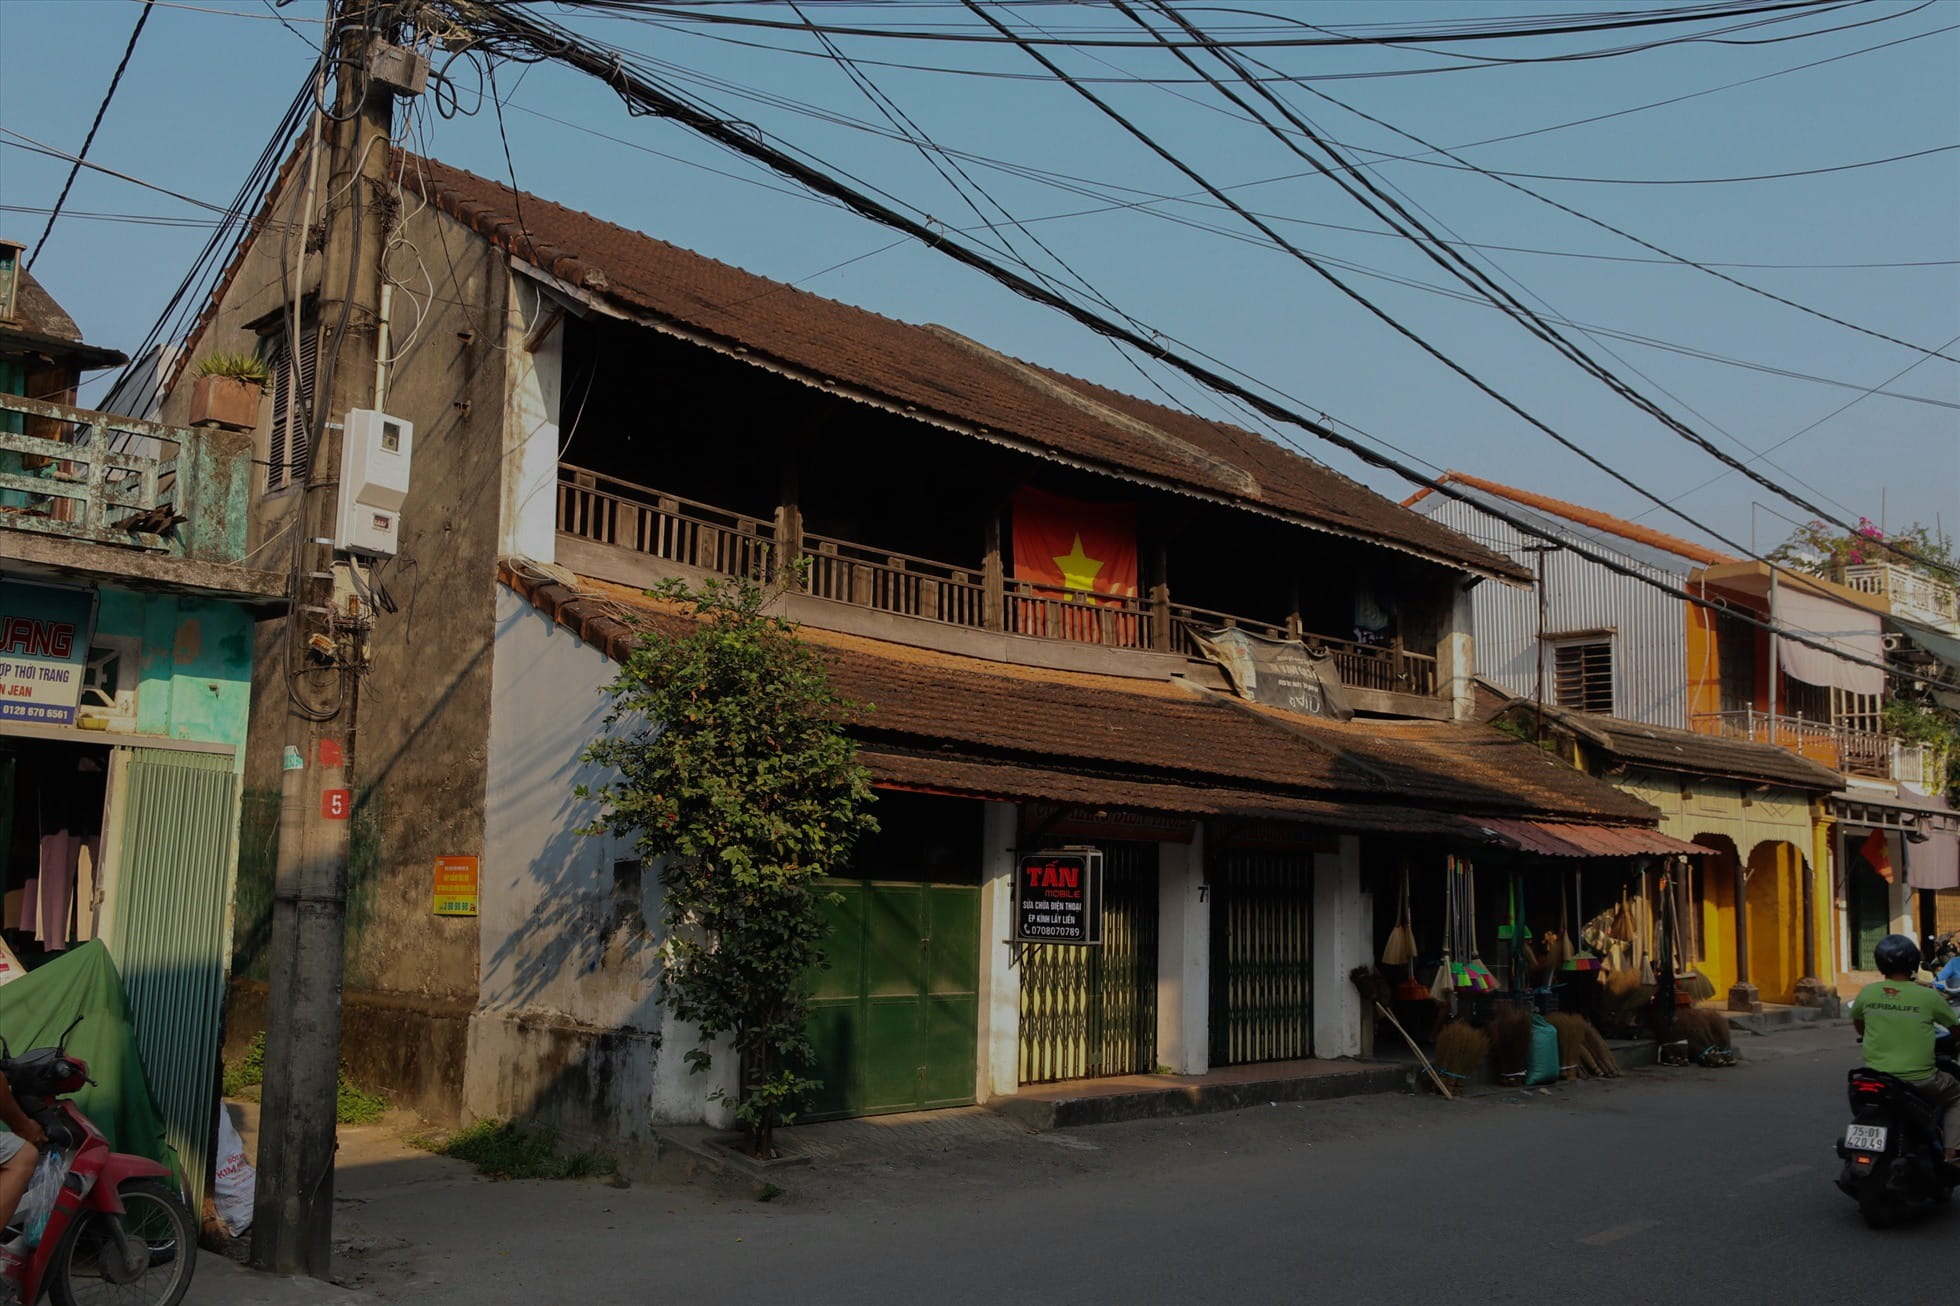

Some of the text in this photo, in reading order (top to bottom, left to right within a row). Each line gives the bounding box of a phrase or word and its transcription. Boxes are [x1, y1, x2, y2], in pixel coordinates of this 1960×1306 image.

[39, 667, 70, 683] TRANG
[8, 684, 32, 697] JEAN
[331, 794, 343, 815] 5
[1026, 860, 1080, 888] TẤN
[1031, 925, 1080, 937] 0708070789
[1866, 1002, 1920, 1012] HERBALIFE
[217, 1165, 236, 1179] KIM
